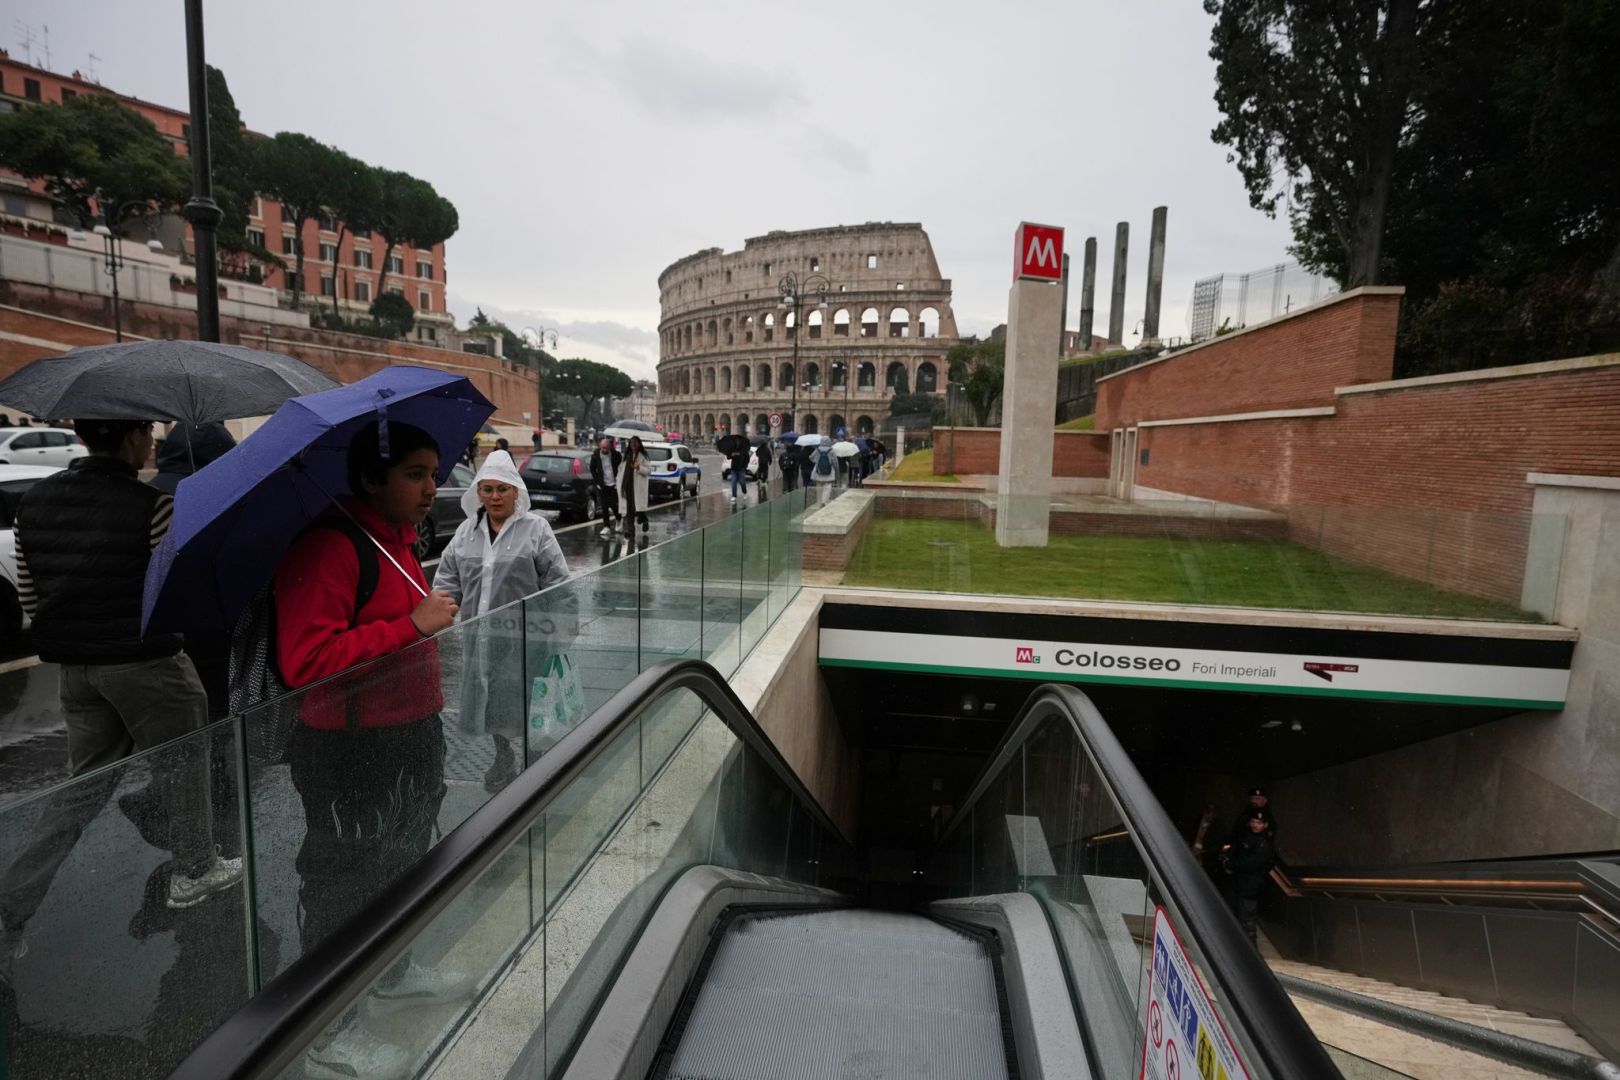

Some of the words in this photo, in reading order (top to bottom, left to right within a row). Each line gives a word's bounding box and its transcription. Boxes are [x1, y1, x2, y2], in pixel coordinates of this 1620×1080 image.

[1025, 235, 1058, 269] M
[1055, 649, 1181, 671] Colosseo
[1192, 662, 1217, 674] Fori
[1221, 663, 1277, 678] Imperiali
